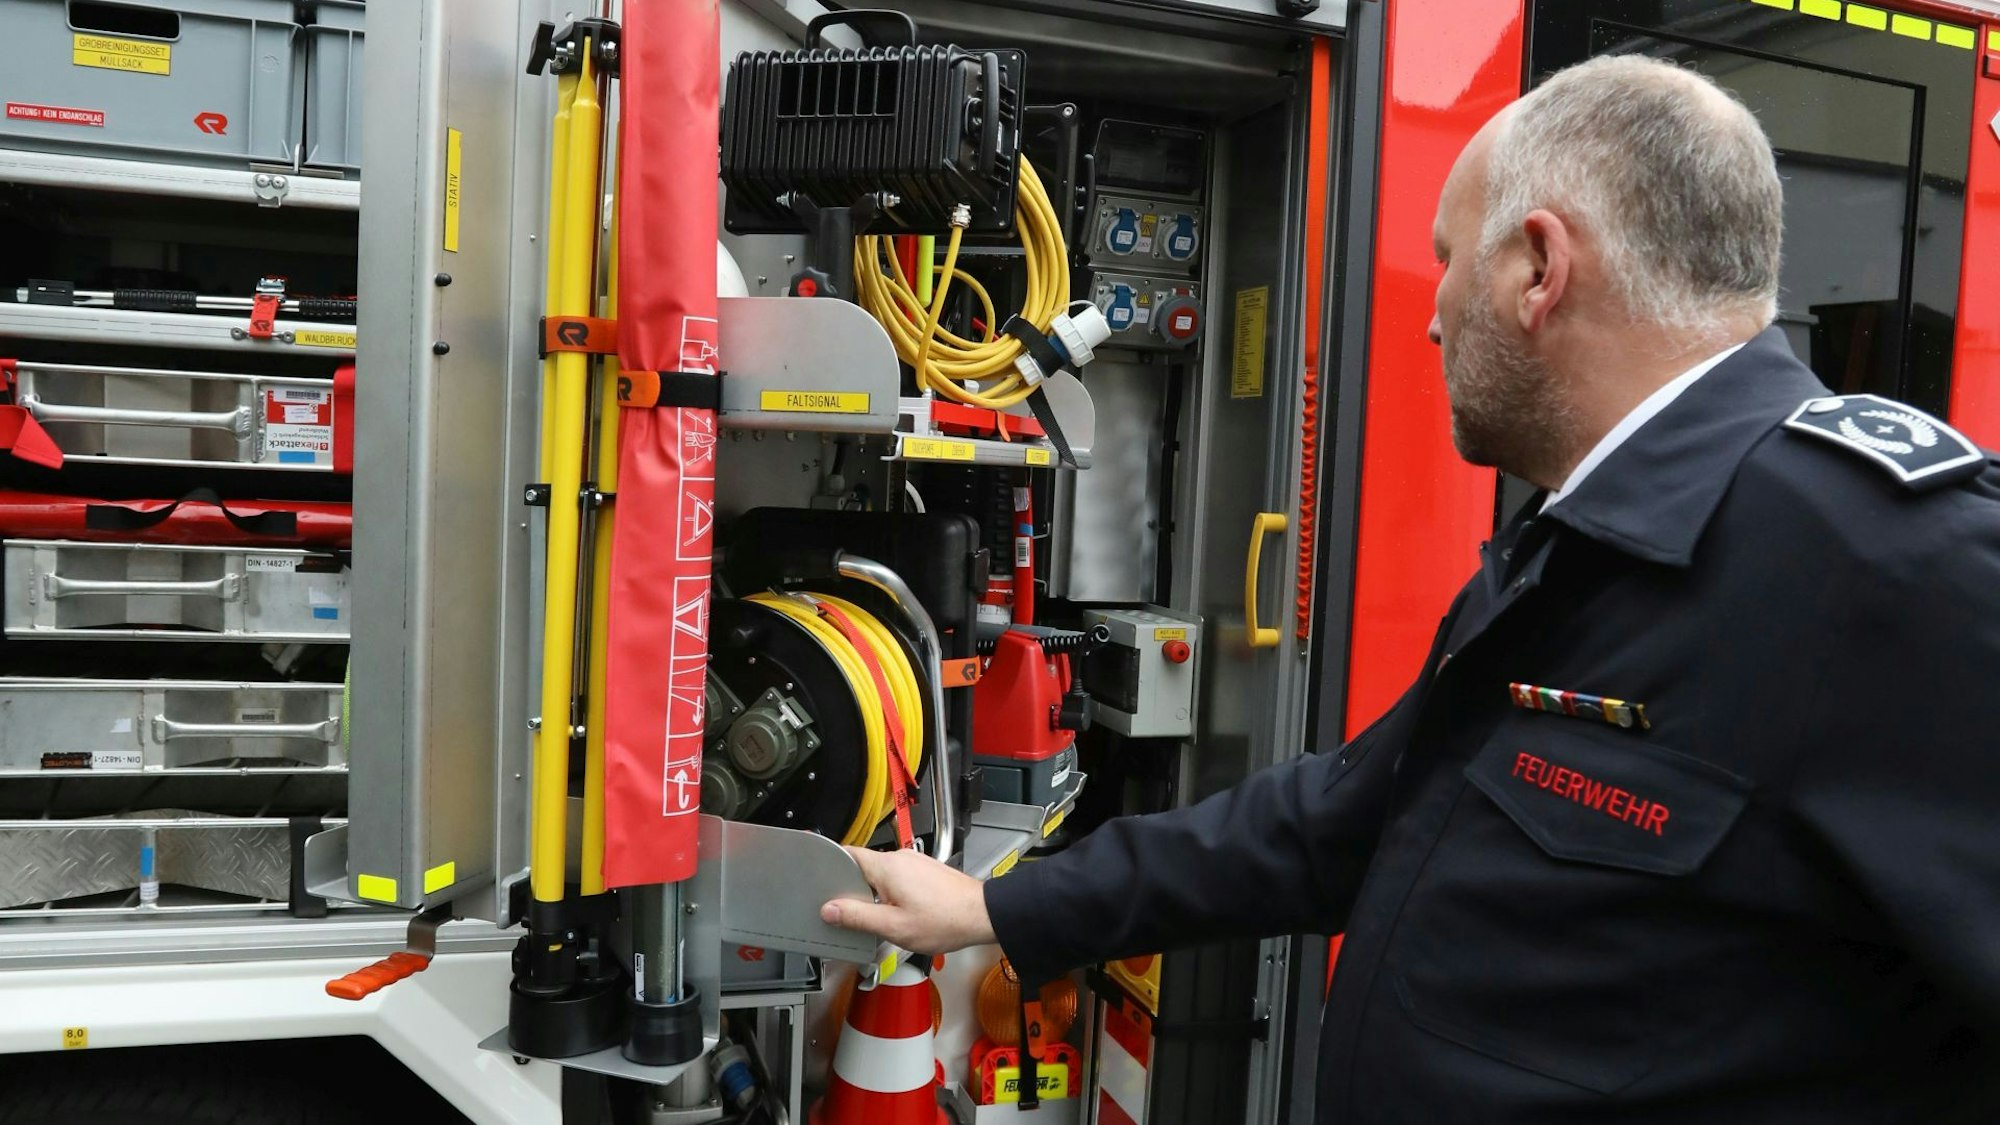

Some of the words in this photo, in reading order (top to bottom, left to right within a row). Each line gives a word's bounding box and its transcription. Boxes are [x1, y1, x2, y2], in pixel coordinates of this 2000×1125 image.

[79, 38, 166, 57] GROBREINIGUNGSSET
[43, 109, 57, 119] KEIN
[58, 110, 103, 123] ENDANSCHLAG
[448, 173, 459, 208] STATIV
[787, 394, 841, 408] FALTSIGNAL
[269, 440, 318, 450] flexattack
[1512, 752, 1669, 836] FEUERWEHR
[67, 1029, 83, 1038] 8,0
